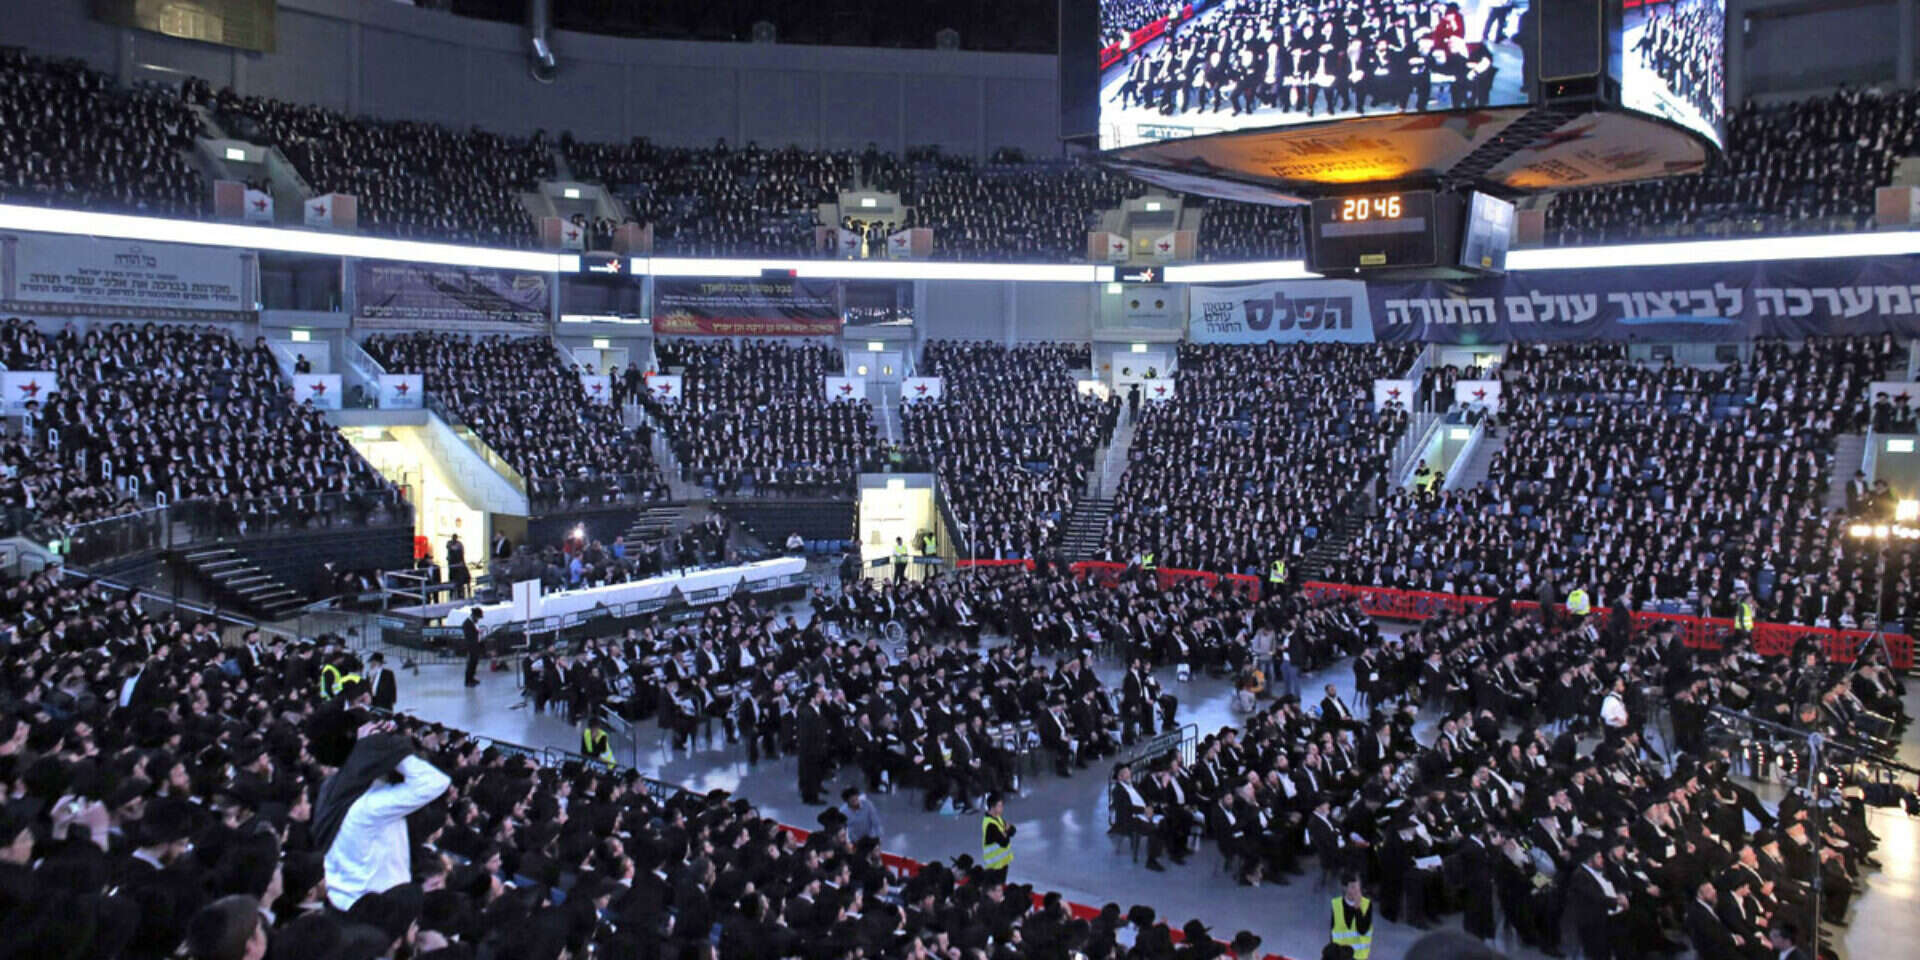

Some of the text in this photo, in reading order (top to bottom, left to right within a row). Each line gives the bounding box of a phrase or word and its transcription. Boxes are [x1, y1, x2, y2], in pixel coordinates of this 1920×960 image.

[30, 273, 61, 283] תורה
[1244, 292, 1353, 331] הפלס
[1385, 297, 1498, 325] התורה
[1505, 289, 1597, 324] עולם
[1608, 281, 1743, 319] לביצור
[1207, 322, 1242, 333] התורה
